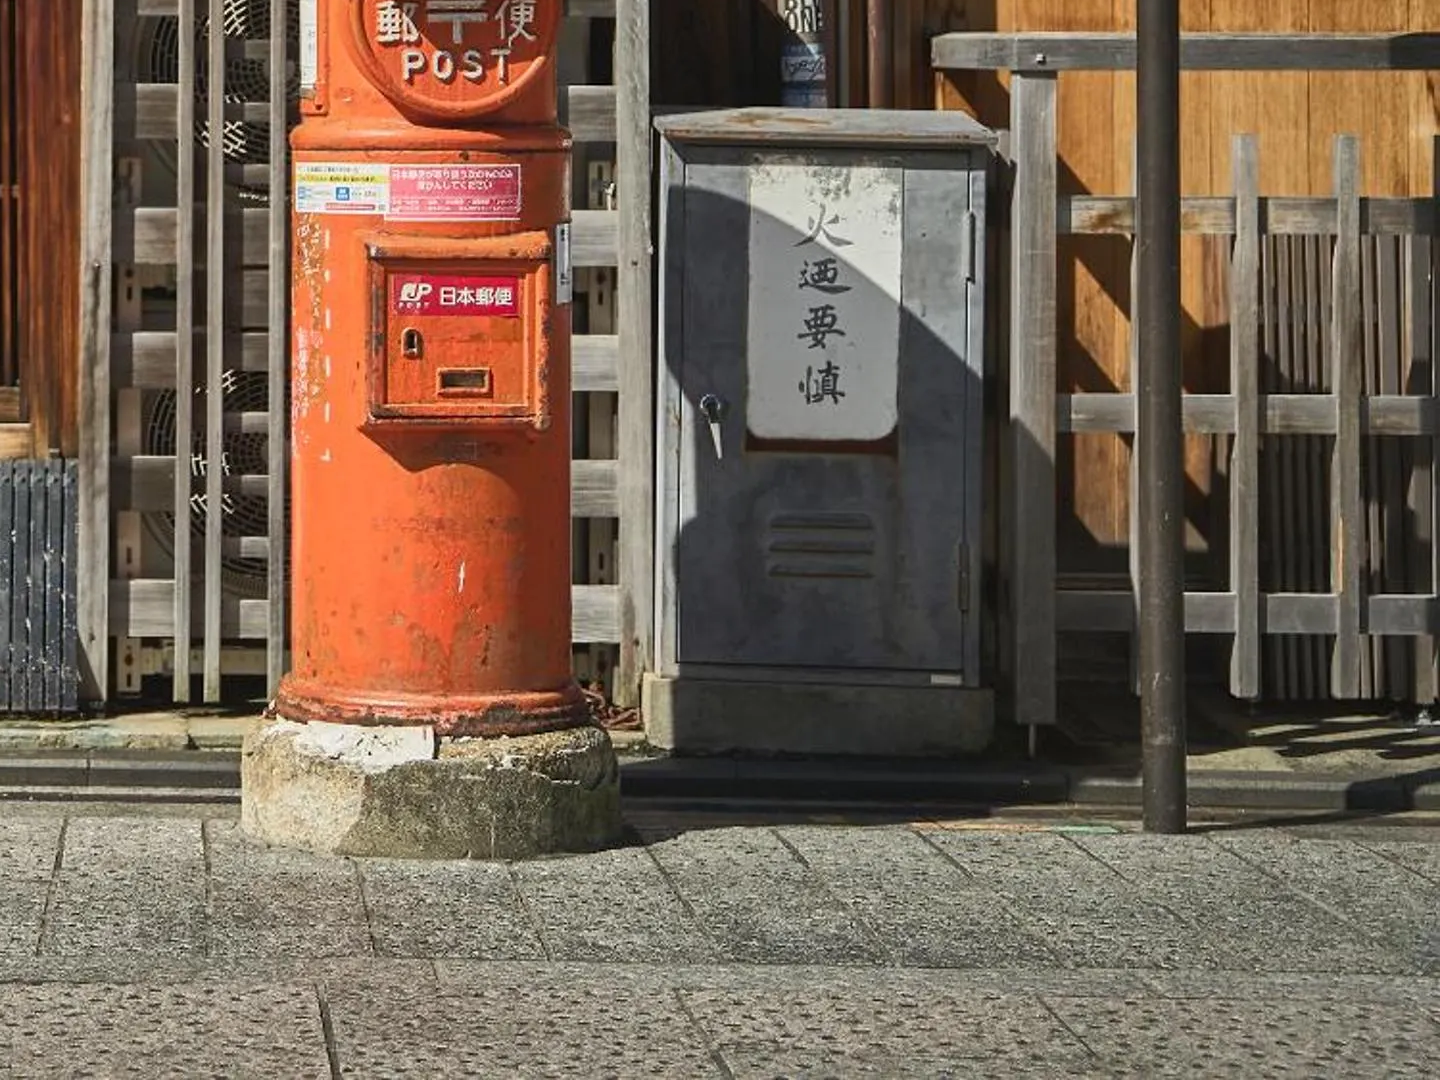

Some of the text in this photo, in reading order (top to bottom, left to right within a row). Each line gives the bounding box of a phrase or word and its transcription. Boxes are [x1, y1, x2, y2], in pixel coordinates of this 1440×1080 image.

[401, 49, 513, 84] POST
[440, 286, 513, 306] 日本郵便
[793, 202, 855, 405] 火迺要慎
